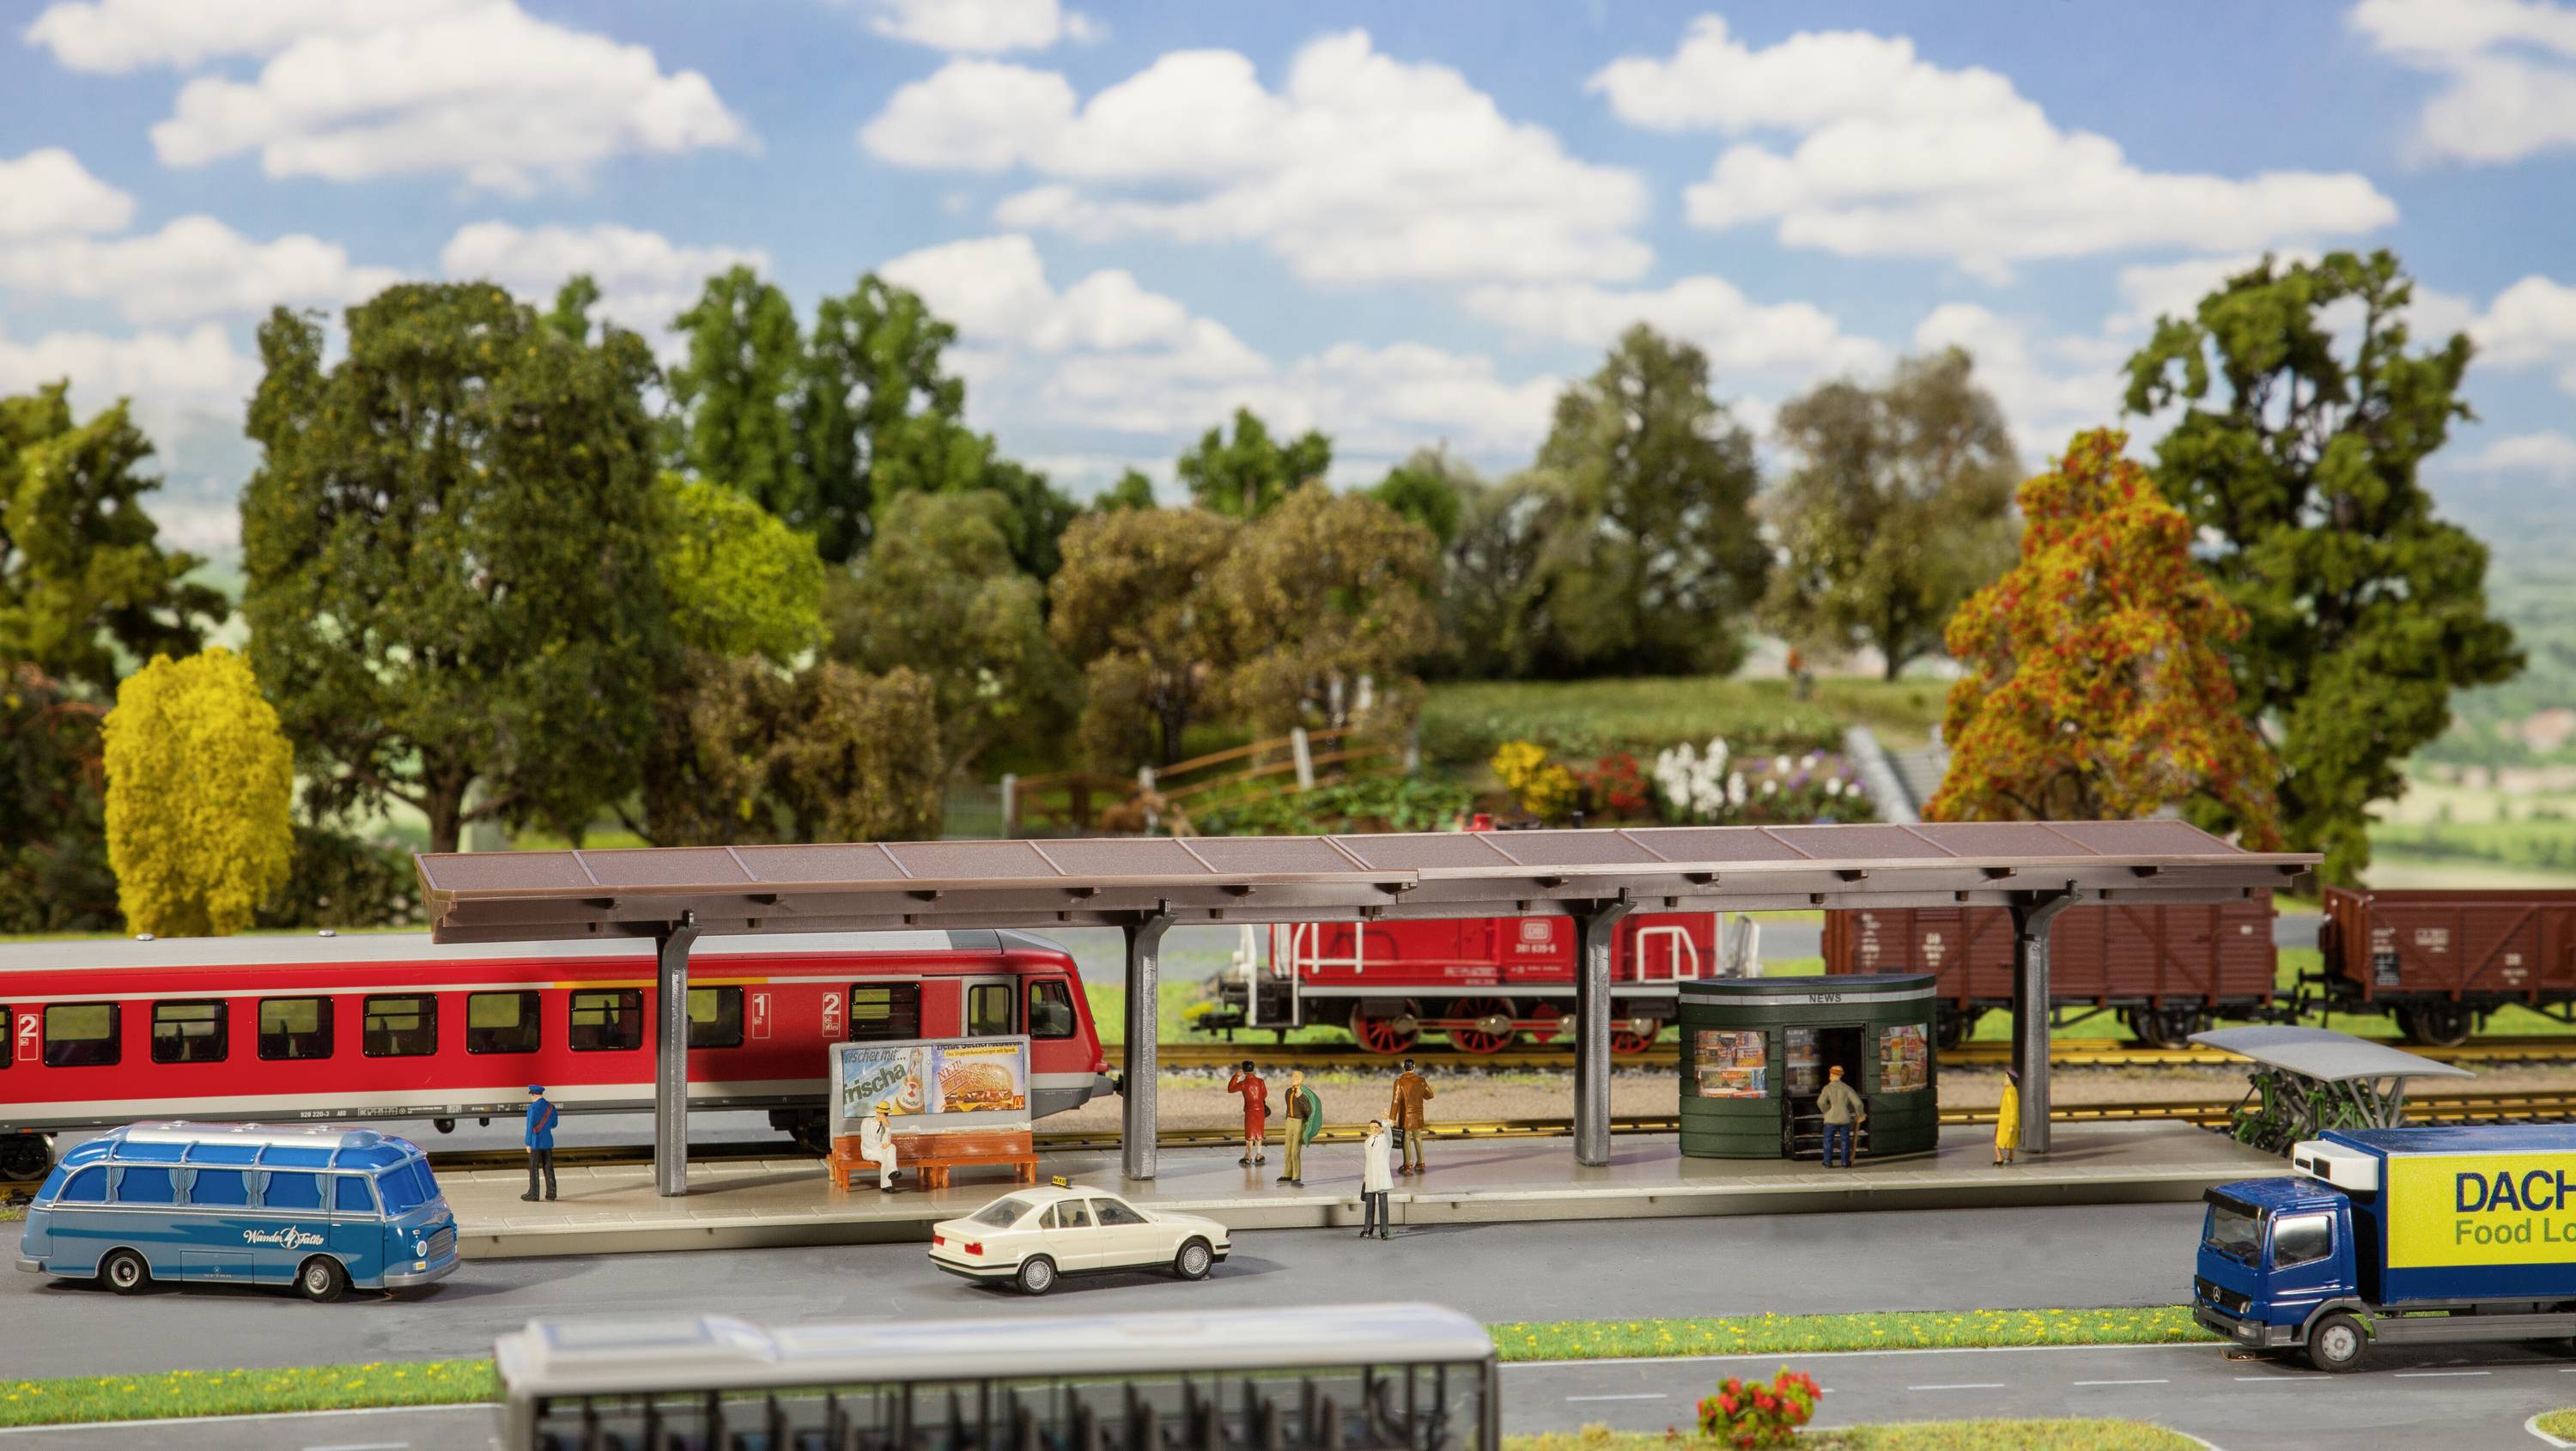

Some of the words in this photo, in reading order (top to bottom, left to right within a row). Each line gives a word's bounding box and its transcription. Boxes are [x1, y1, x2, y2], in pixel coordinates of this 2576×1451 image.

[754, 995, 765, 1017] 1
[823, 994, 840, 1015] 2
[1808, 993, 1842, 1003] NEWS
[20, 1016, 39, 1037] 2
[2455, 1169, 2576, 1212] DACH
[243, 1229, 283, 1244] Wander
[2456, 1217, 2531, 1245] Food
[2543, 1217, 2576, 1243] Lo
